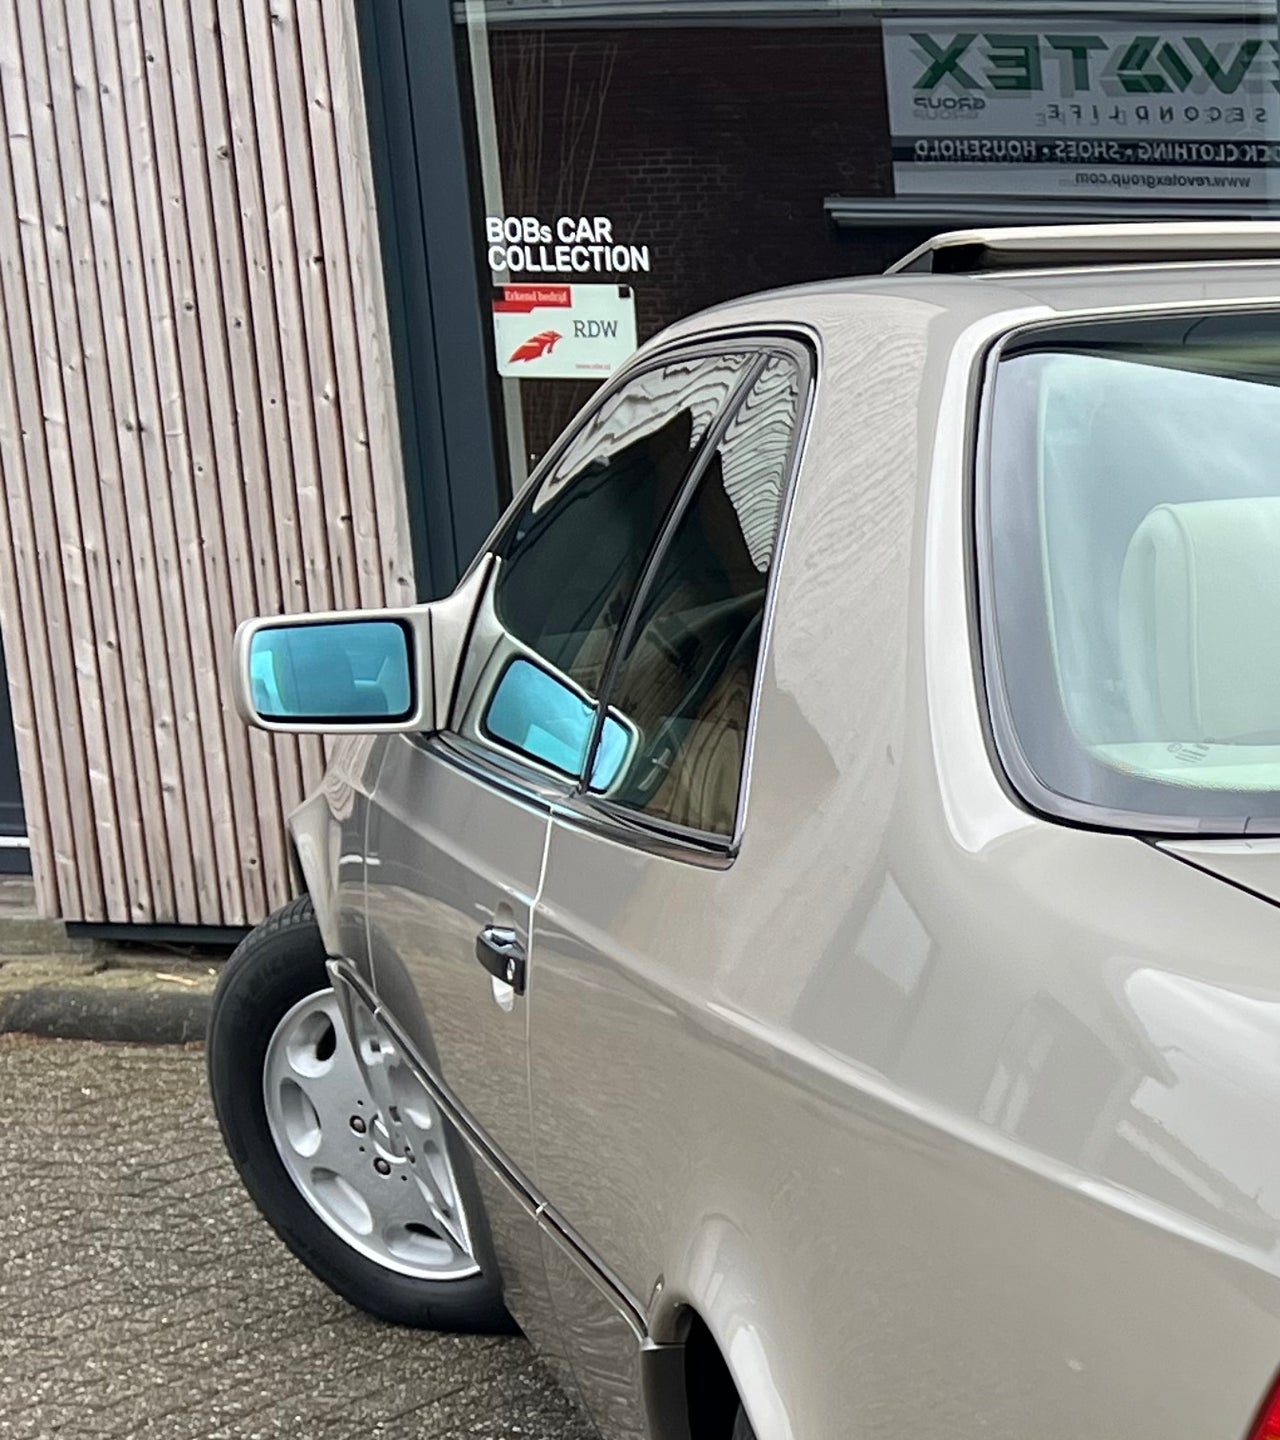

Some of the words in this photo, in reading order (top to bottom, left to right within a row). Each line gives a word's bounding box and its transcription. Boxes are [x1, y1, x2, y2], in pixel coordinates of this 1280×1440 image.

[485, 216, 552, 243] BOBs
[556, 216, 613, 243] CAR
[488, 245, 650, 272] COLLECTION
[573, 320, 618, 338] RDW
